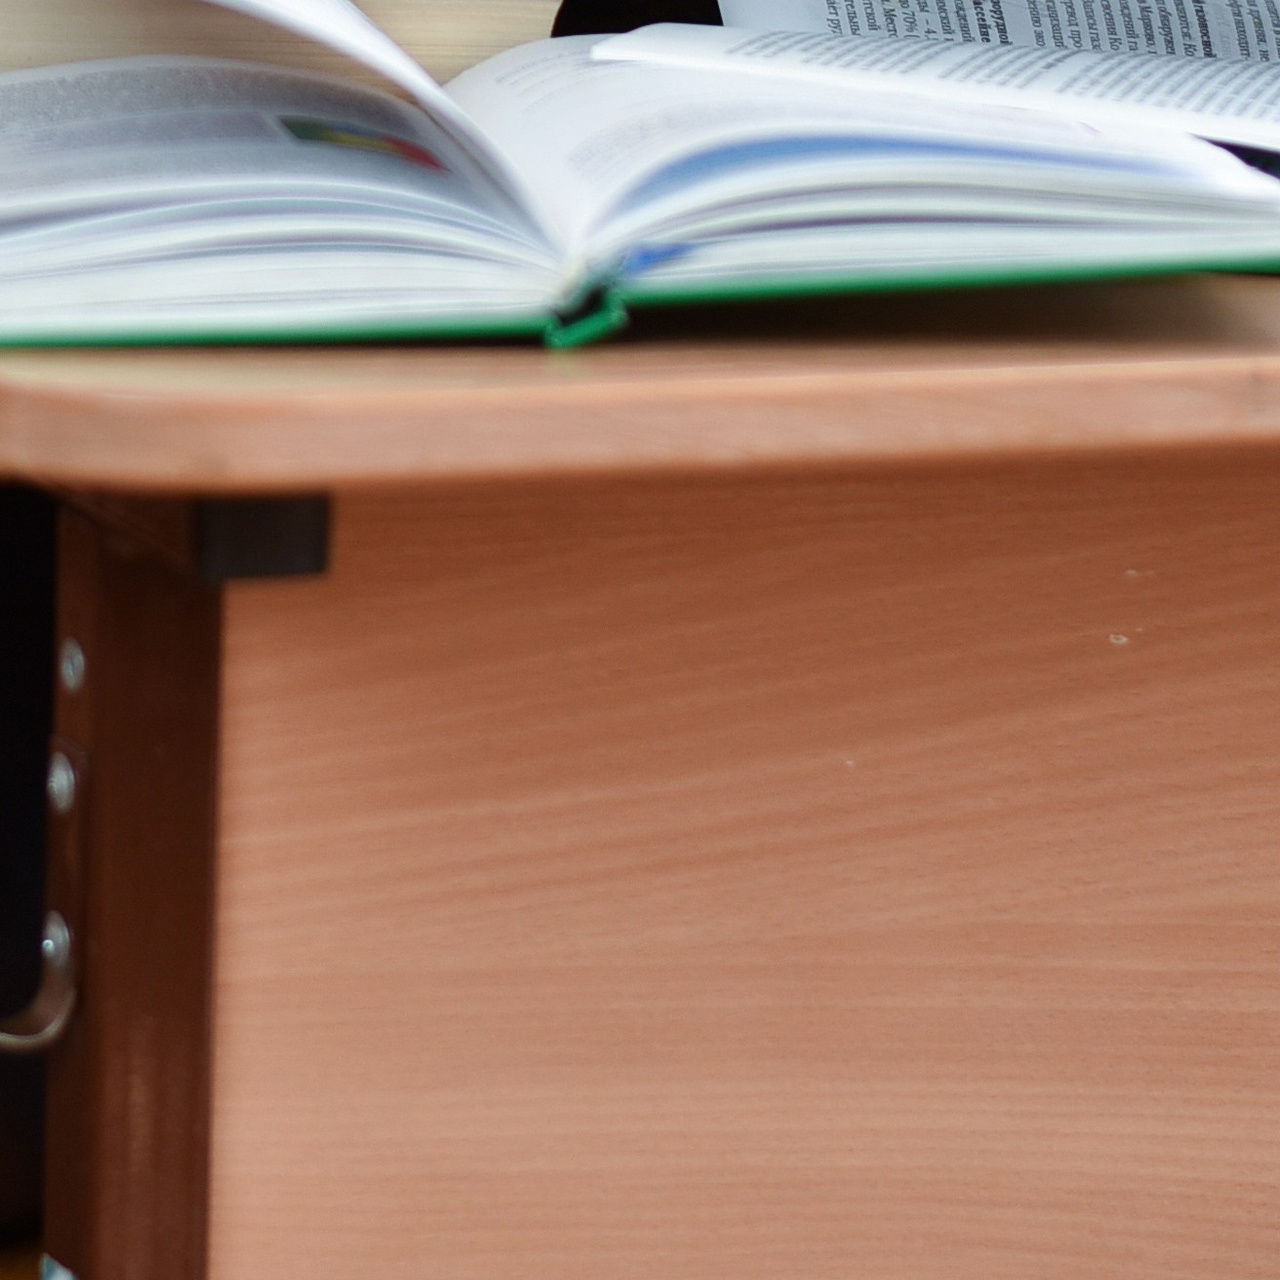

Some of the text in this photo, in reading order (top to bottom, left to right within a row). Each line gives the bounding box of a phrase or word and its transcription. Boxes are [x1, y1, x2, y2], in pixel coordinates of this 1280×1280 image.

[901, 10, 919, 34] 70%
[1193, 3, 1218, 59] газоносной
[1067, 29, 1083, 49] про
[1233, 18, 1252, 61] находит-
